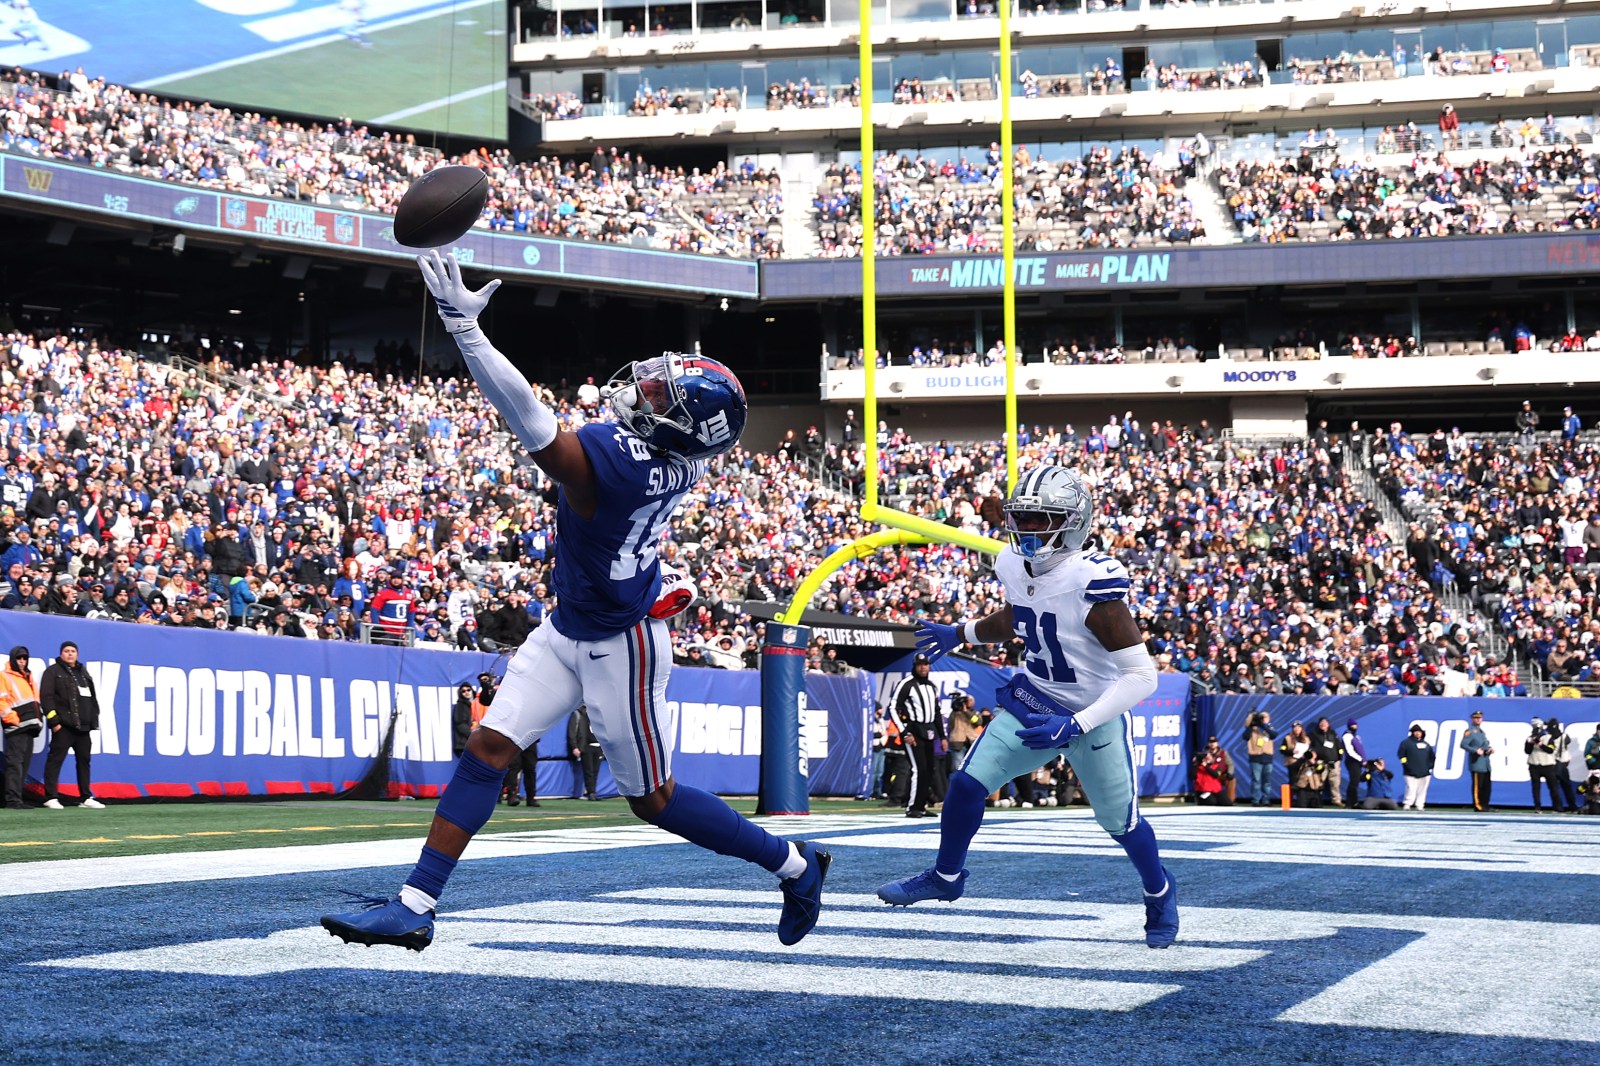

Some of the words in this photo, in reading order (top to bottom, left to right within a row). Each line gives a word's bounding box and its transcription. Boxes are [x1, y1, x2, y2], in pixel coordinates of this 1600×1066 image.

[266, 204, 316, 223] AROUND
[254, 216, 278, 234] THE
[281, 219, 327, 241] LEAGUE
[911, 268, 940, 282] TAKE
[941, 268, 949, 281] A
[1056, 263, 1089, 279] MAKE
[1091, 263, 1100, 277] A
[1101, 254, 1170, 283] PLAN
[925, 377, 961, 388] BUD
[965, 375, 1005, 387] LIGH
[853, 630, 895, 647] STADIUM
[1012, 604, 1077, 683] 21
[128, 664, 345, 758] FOOTBALL
[349, 679, 482, 762] GIAN
